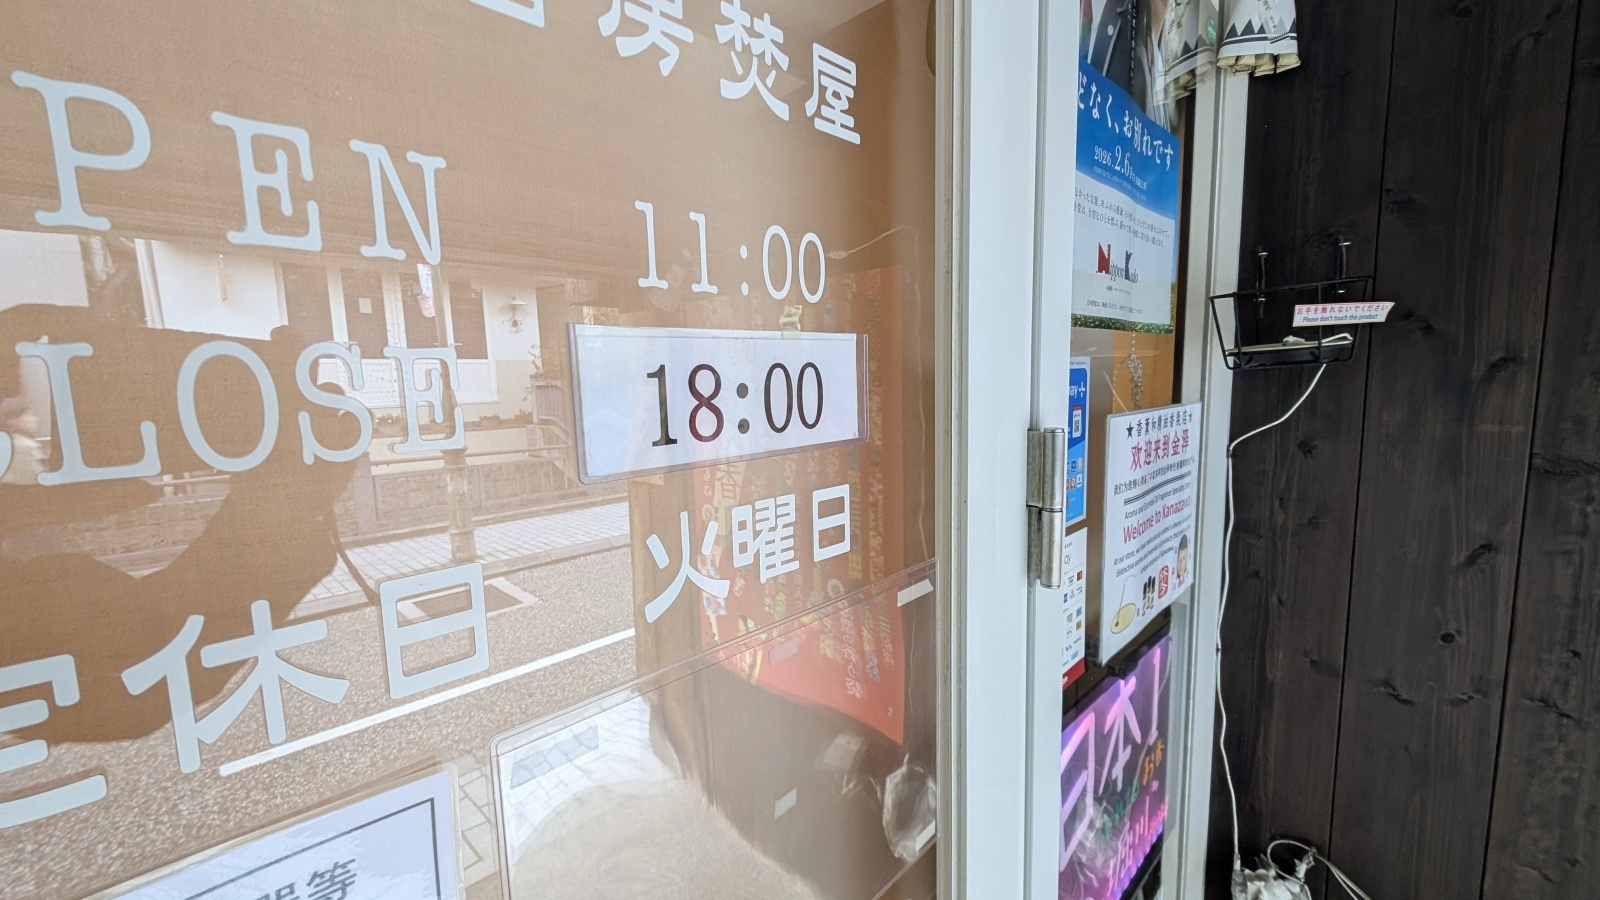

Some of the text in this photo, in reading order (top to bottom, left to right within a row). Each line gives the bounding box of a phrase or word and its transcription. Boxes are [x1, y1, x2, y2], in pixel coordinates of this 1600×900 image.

[468, 0, 861, 145] 房焚屋
[633, 200, 826, 304] 11:00
[1297, 304, 1388, 315] お手を触れないでください
[1358, 313, 1379, 321] product
[0, 339, 467, 487] LOSE
[645, 361, 825, 448] 18:00
[644, 484, 851, 623] 火曜日
[1123, 517, 1153, 544] Welcome
[1154, 510, 1162, 525] to
